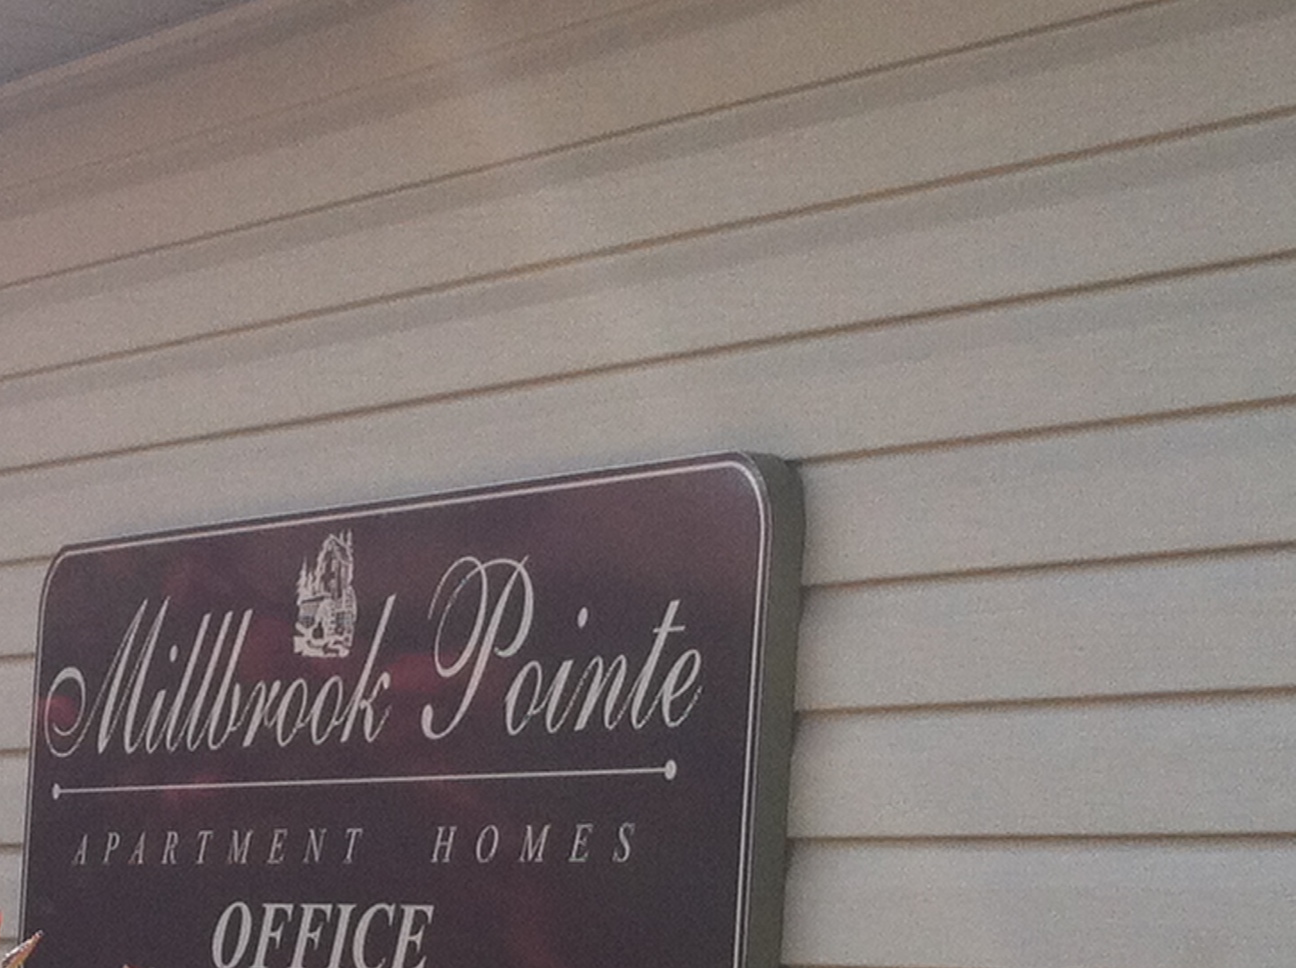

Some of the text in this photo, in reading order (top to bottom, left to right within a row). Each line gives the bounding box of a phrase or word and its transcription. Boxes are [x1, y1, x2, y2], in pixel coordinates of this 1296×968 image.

[43, 553, 703, 758] Millbrook Pointe
[72, 821, 638, 867] APARTMENT HOMES
